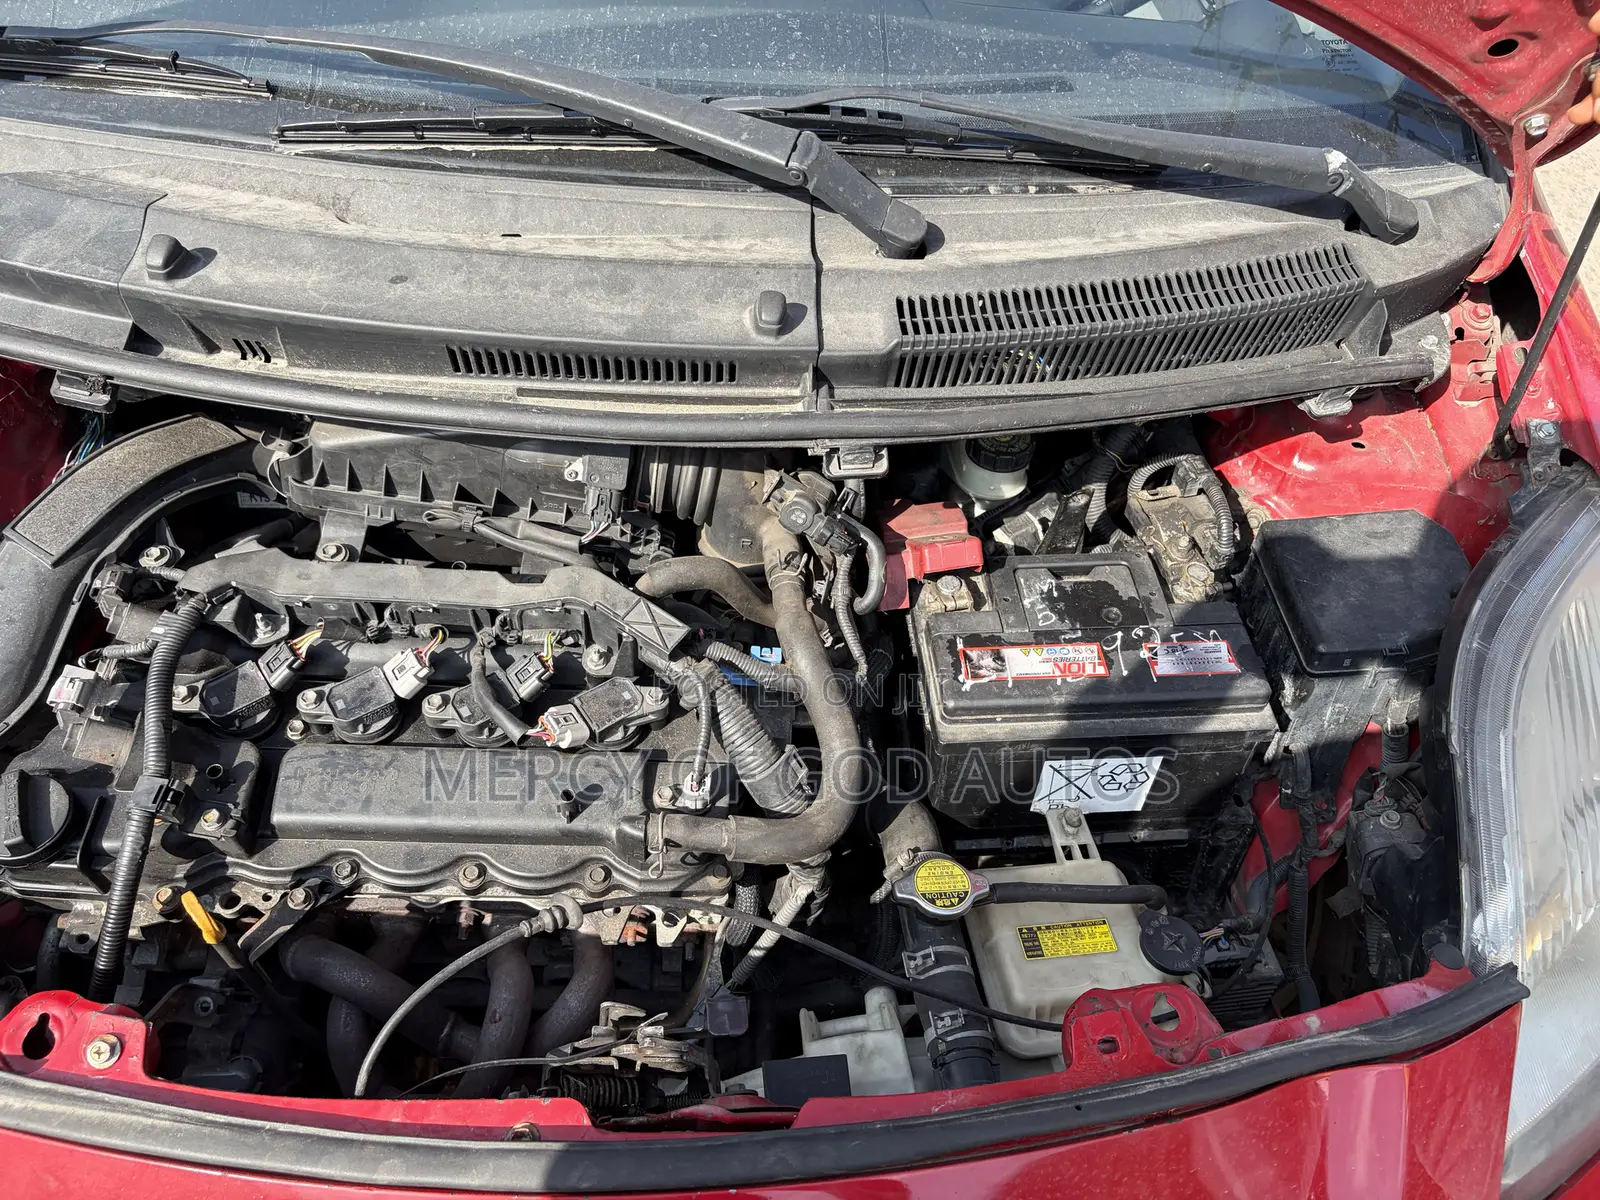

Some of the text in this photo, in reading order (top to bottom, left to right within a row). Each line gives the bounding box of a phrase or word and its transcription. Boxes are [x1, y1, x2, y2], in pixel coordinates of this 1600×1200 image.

[1052, 655, 1097, 663] BATTERIES
[1052, 661, 1097, 675] LION
[925, 891, 965, 899] CAUTION
